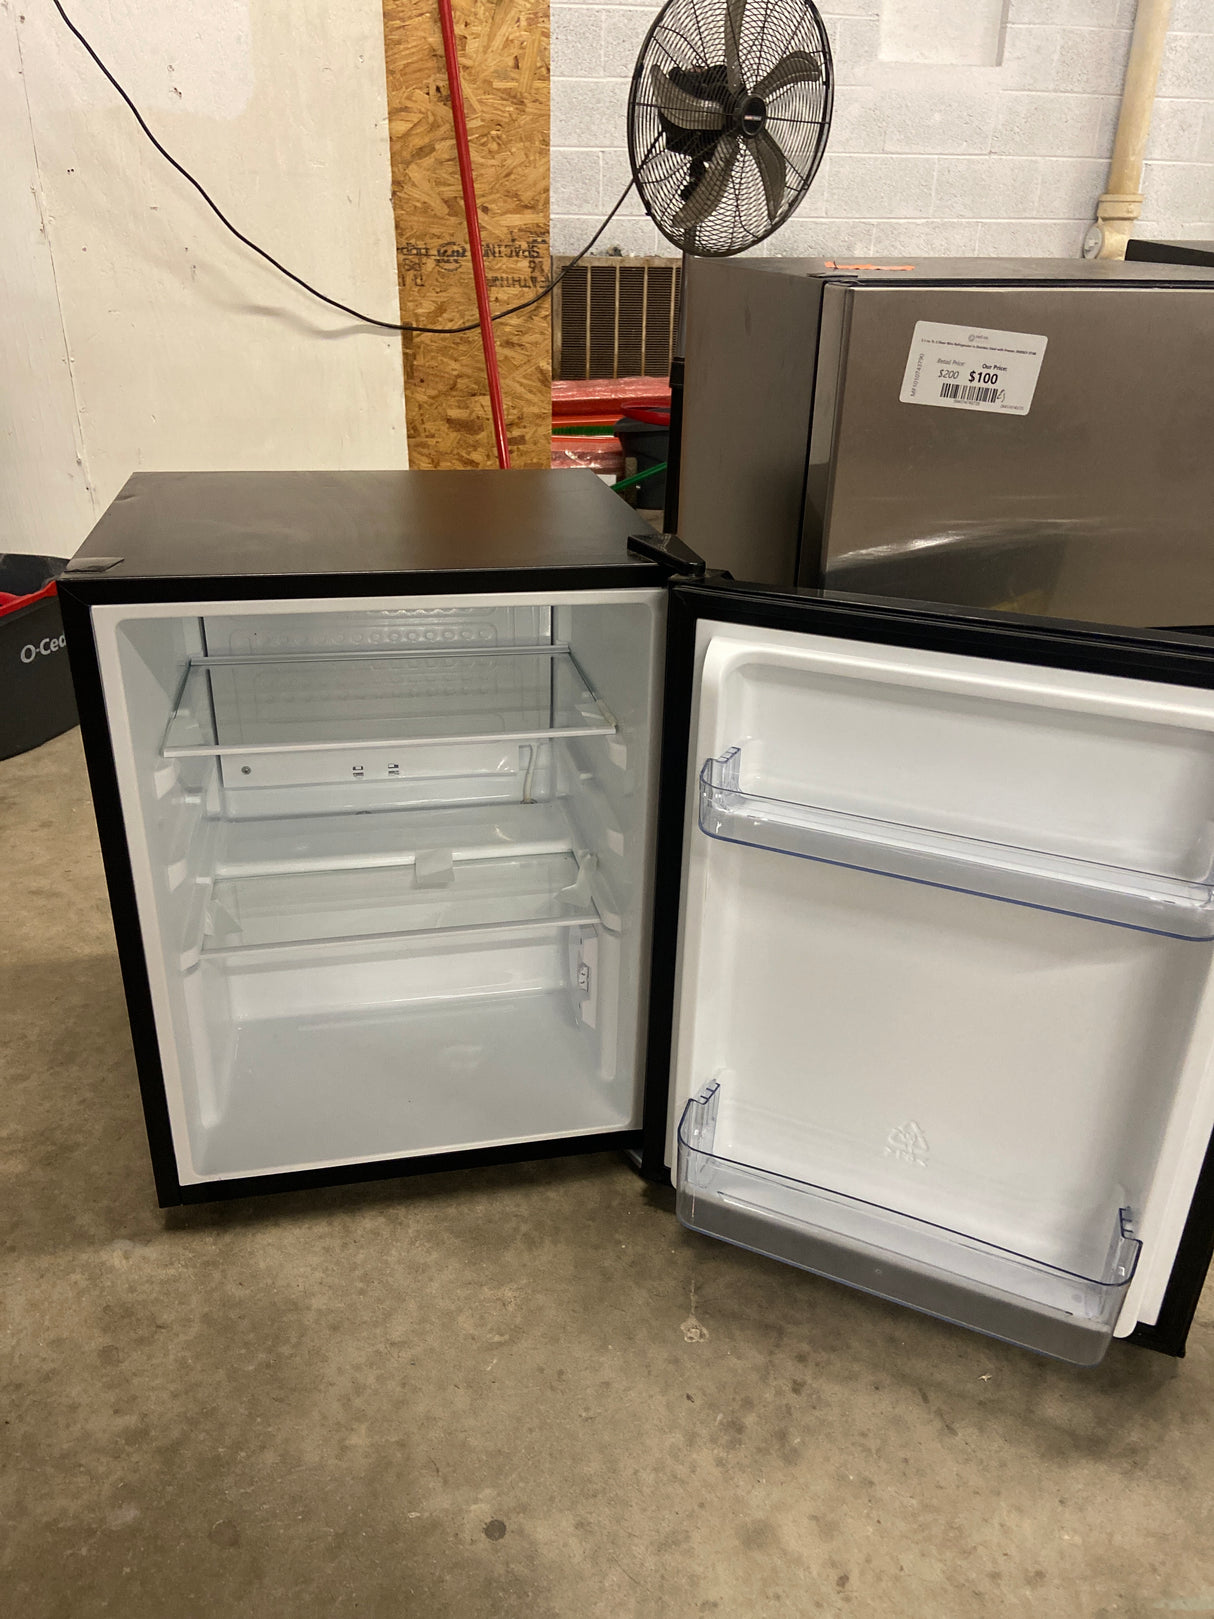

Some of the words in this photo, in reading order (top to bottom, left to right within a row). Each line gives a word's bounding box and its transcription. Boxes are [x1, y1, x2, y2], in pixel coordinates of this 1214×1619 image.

[482, 244, 540, 258] SPACIN
[982, 363, 993, 371] Our
[993, 364, 1008, 372] Price:
[938, 369, 959, 380] $200
[968, 370, 999, 385] $100
